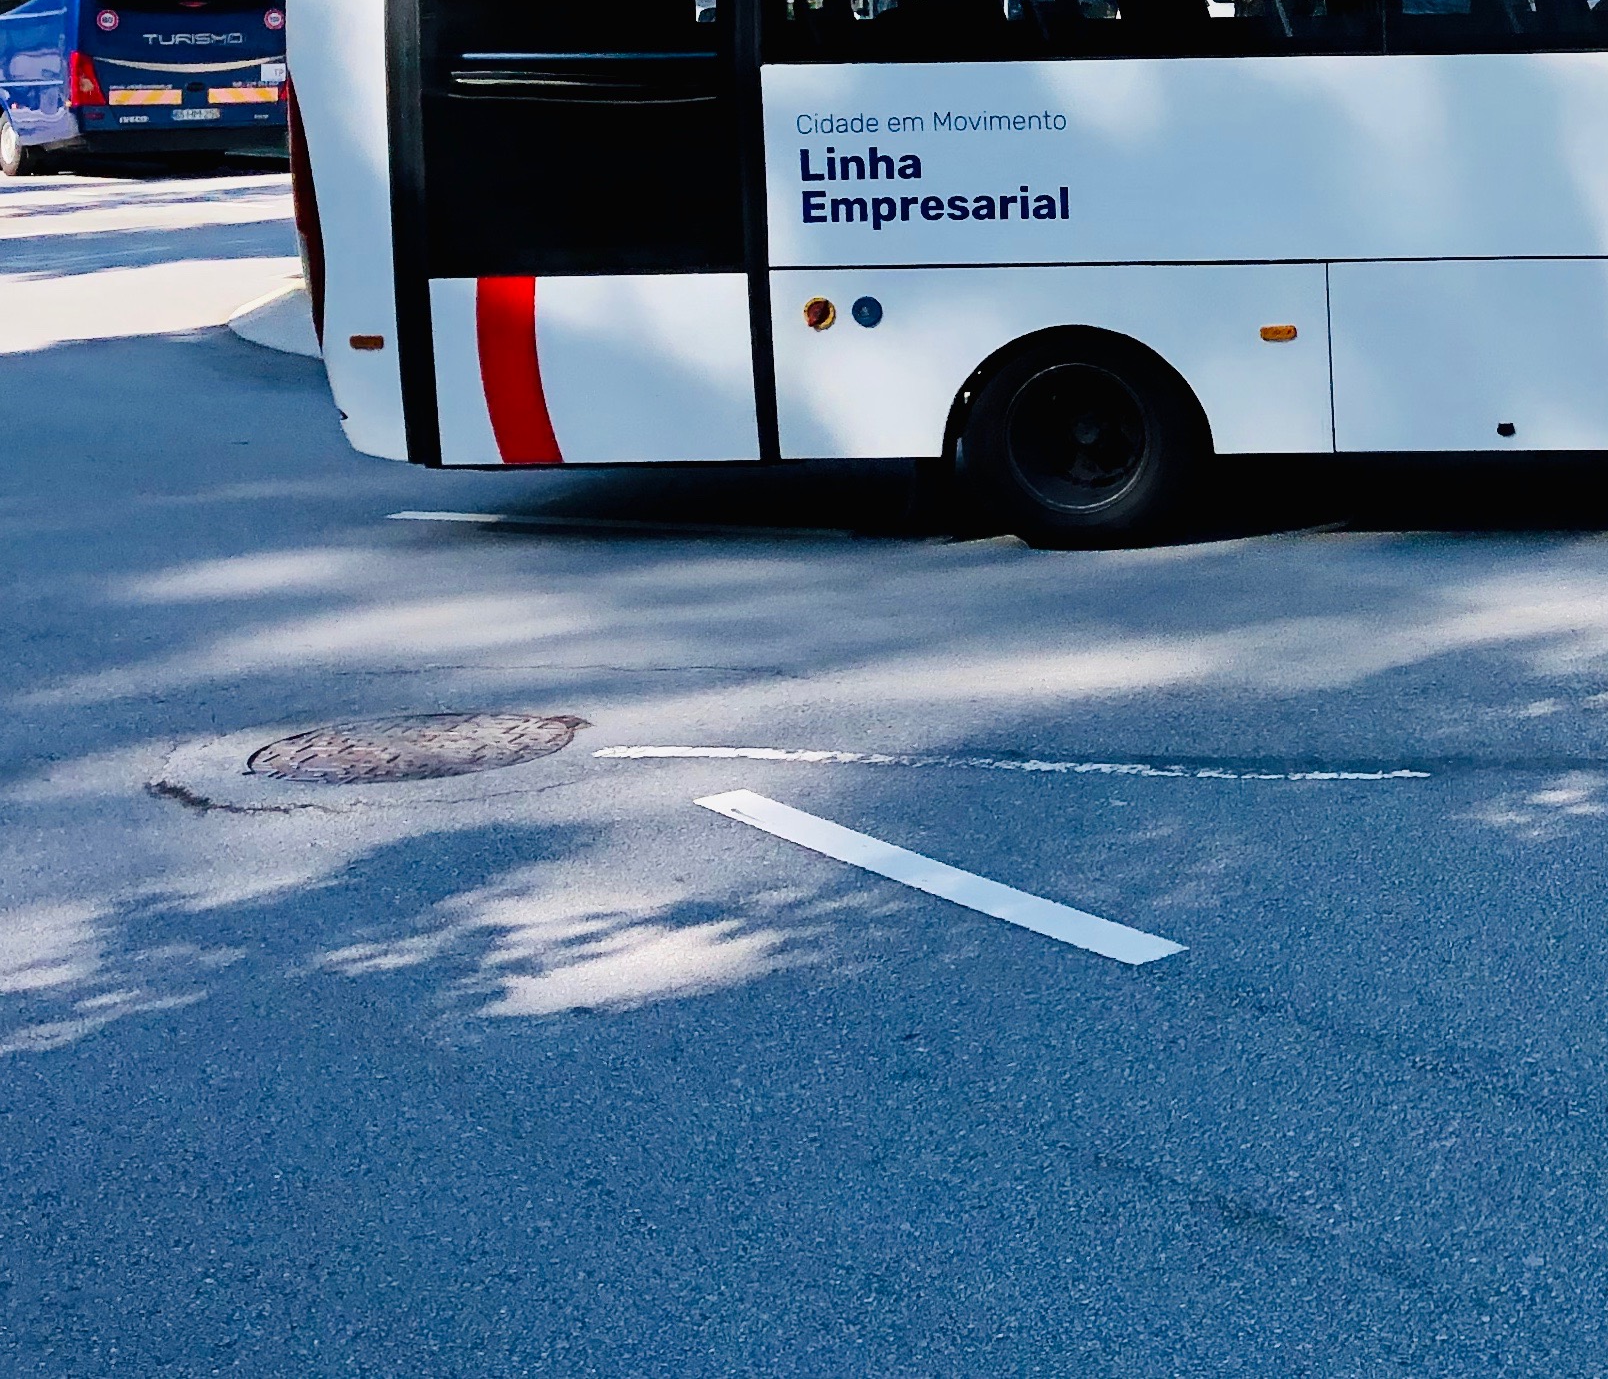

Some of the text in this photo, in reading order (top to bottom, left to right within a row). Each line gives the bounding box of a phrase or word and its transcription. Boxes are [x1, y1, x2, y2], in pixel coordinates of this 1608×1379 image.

[142, 33, 243, 46] TURISMO
[796, 110, 1067, 135] Cidade em Movimento
[799, 146, 922, 182] Linha
[801, 185, 1070, 231] Empresarial
